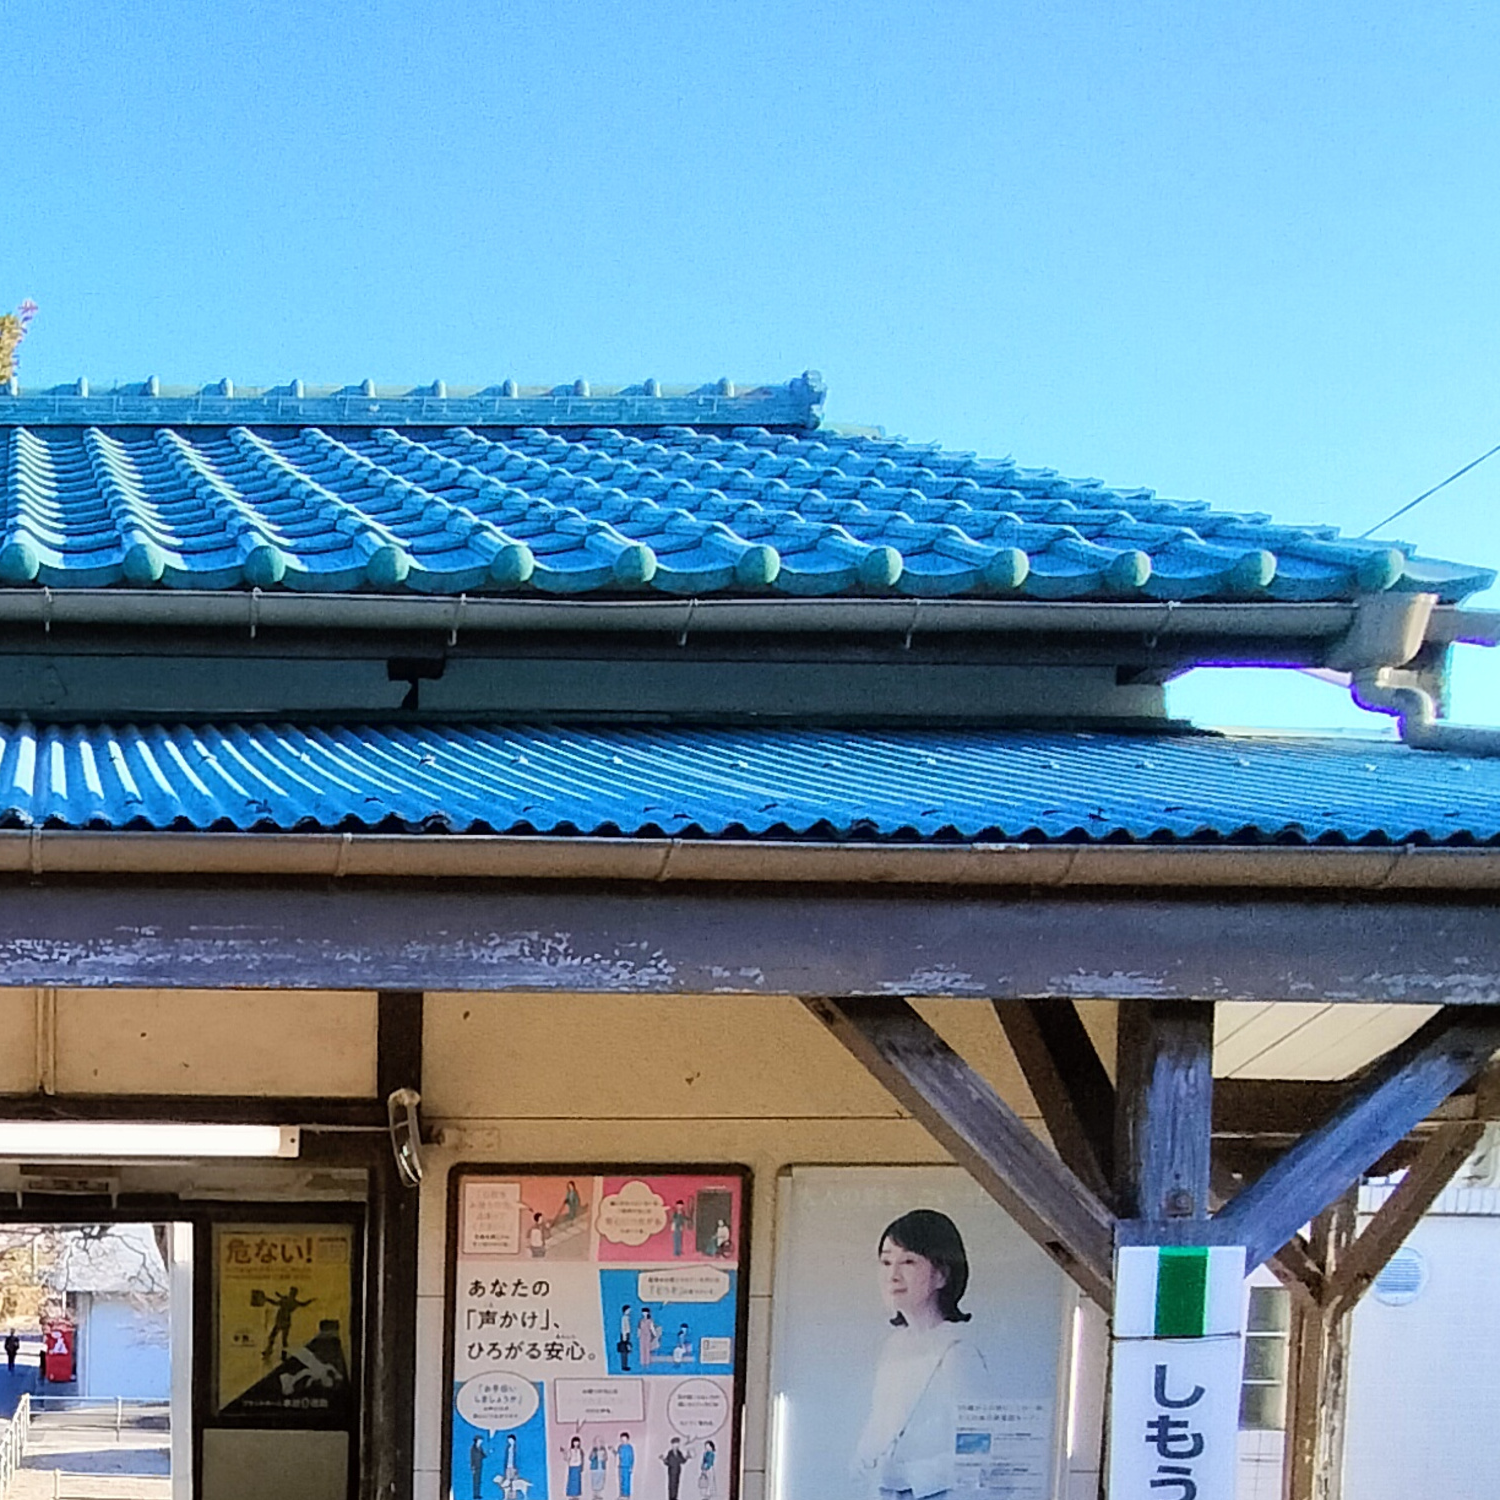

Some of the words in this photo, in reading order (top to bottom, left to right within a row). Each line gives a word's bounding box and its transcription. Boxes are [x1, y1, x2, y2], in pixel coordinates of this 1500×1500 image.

[468, 1278, 550, 1298] あなたの
[466, 1308, 560, 1331] 「声かけ」、
[467, 1340, 596, 1361] ひろがる安心。
